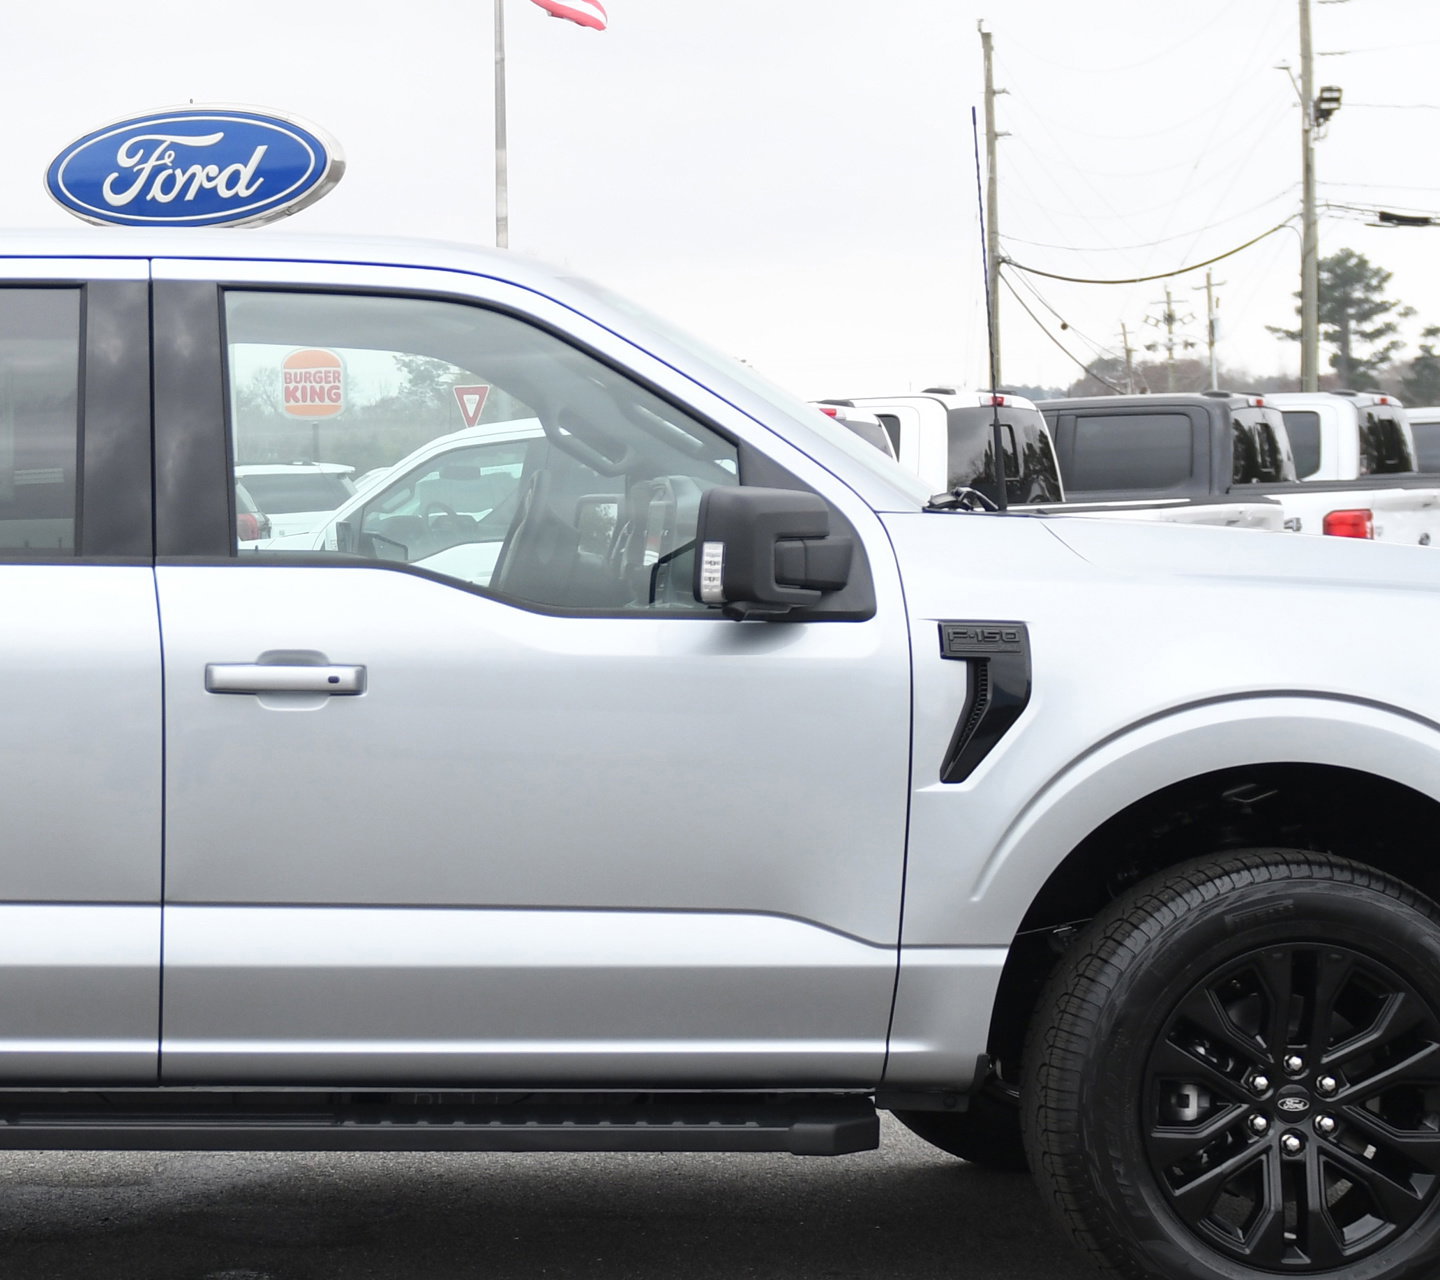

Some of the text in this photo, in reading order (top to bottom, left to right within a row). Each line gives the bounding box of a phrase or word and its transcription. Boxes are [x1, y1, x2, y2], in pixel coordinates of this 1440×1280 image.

[103, 132, 268, 206] Ford
[284, 370, 341, 385] BURGER
[284, 385, 341, 404] KING
[948, 628, 1021, 643] F-150
